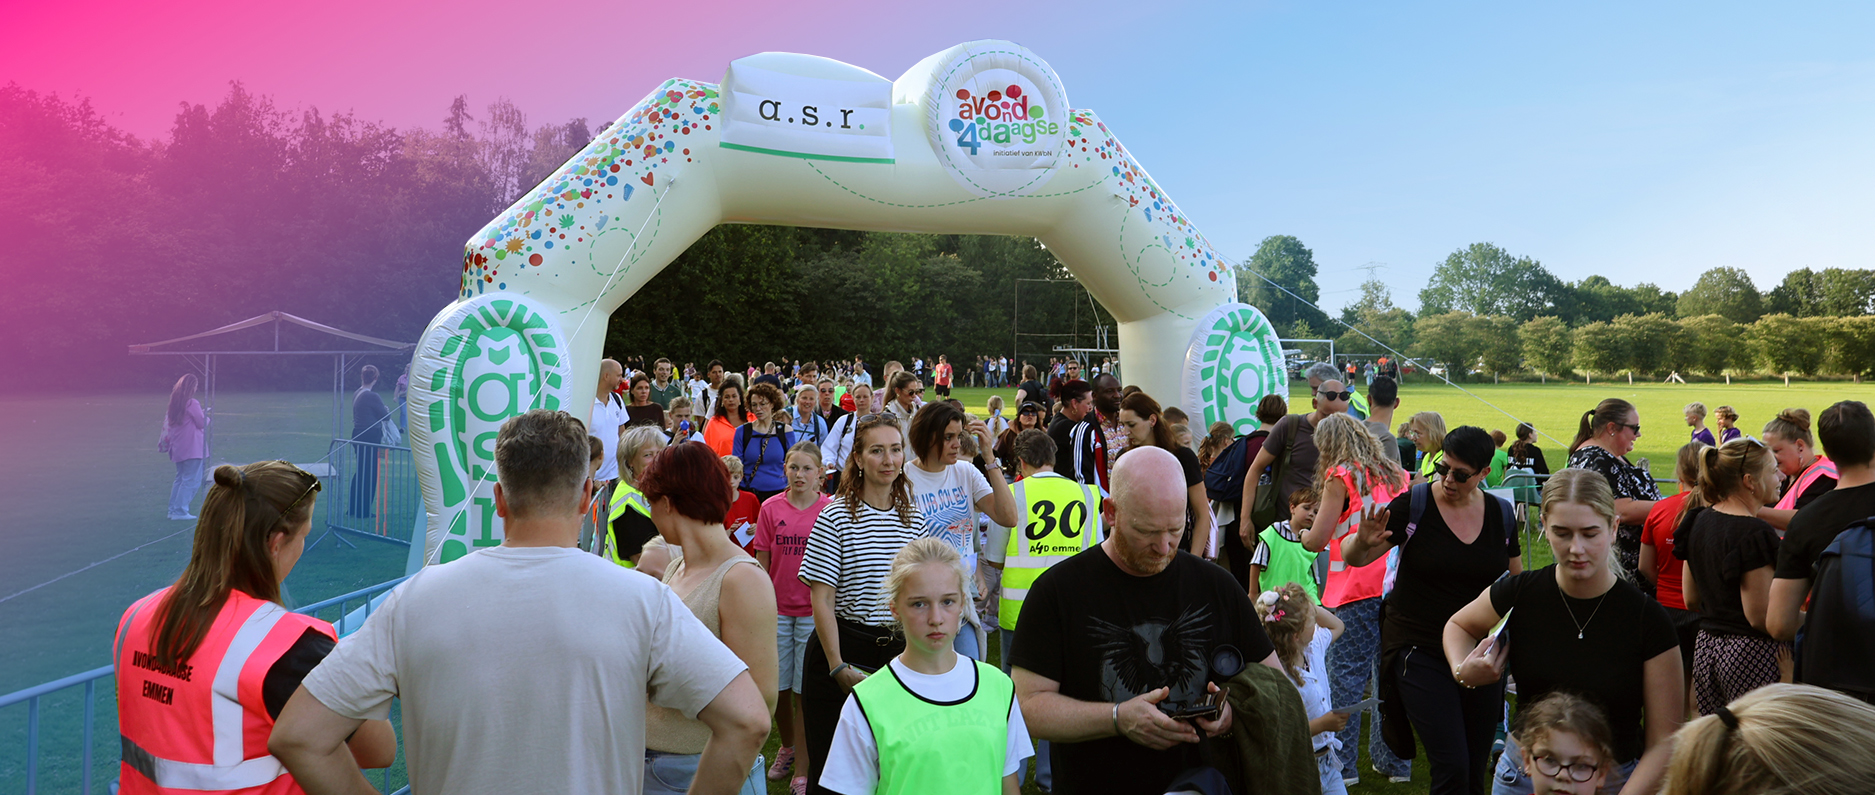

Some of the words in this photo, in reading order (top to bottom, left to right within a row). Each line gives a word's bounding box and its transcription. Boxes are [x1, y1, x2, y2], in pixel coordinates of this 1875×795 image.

[758, 99, 865, 129] a.s.r.
[958, 95, 1028, 122] avond
[957, 119, 1059, 156] 4daagse
[937, 485, 968, 511] SOLEIL
[1025, 499, 1087, 540] 30
[782, 546, 793, 555] FLY
[1029, 541, 1050, 554] A4D
[142, 680, 174, 706] EMMEN
